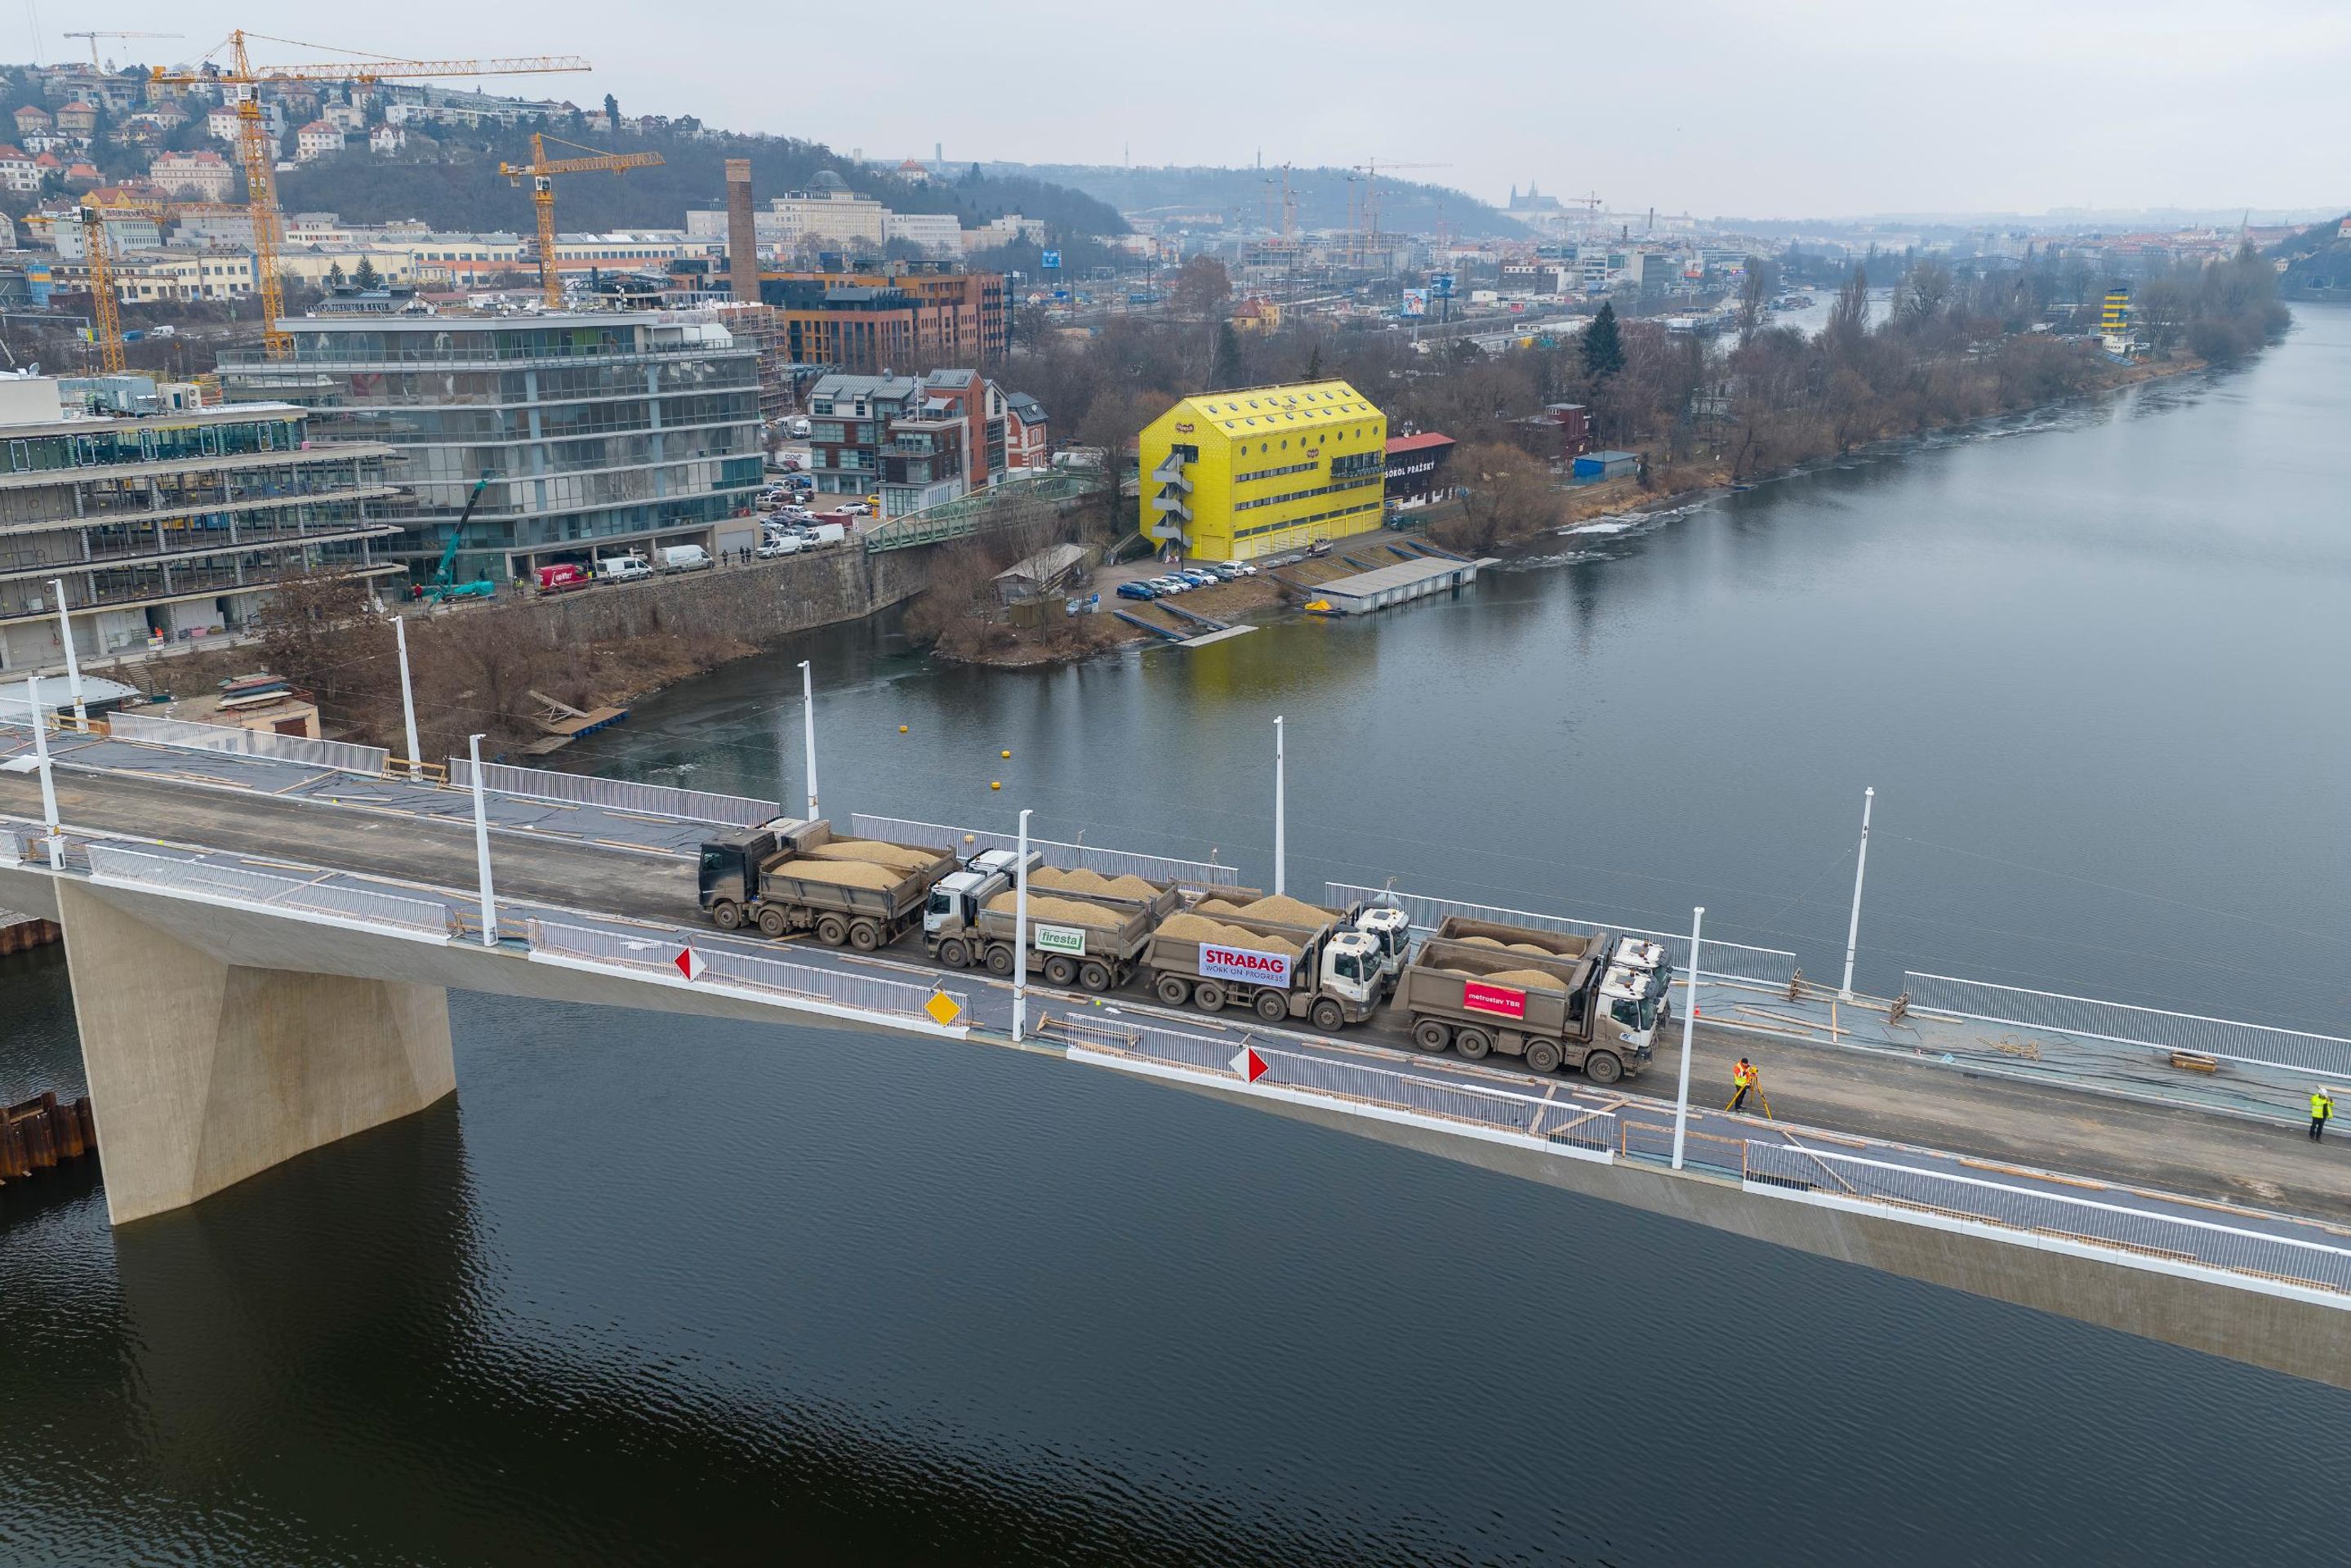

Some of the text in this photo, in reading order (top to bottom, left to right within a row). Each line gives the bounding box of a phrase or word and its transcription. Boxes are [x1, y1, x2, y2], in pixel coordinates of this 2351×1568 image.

[1385, 467, 1405, 479] SOKOL
[1042, 931, 1077, 945] firesta
[1205, 949, 1285, 973] STRABAG
[1205, 964, 1228, 974] WORK
[1245, 969, 1284, 982] PROGRESS
[1468, 993, 1521, 1008] metrostav TBR
